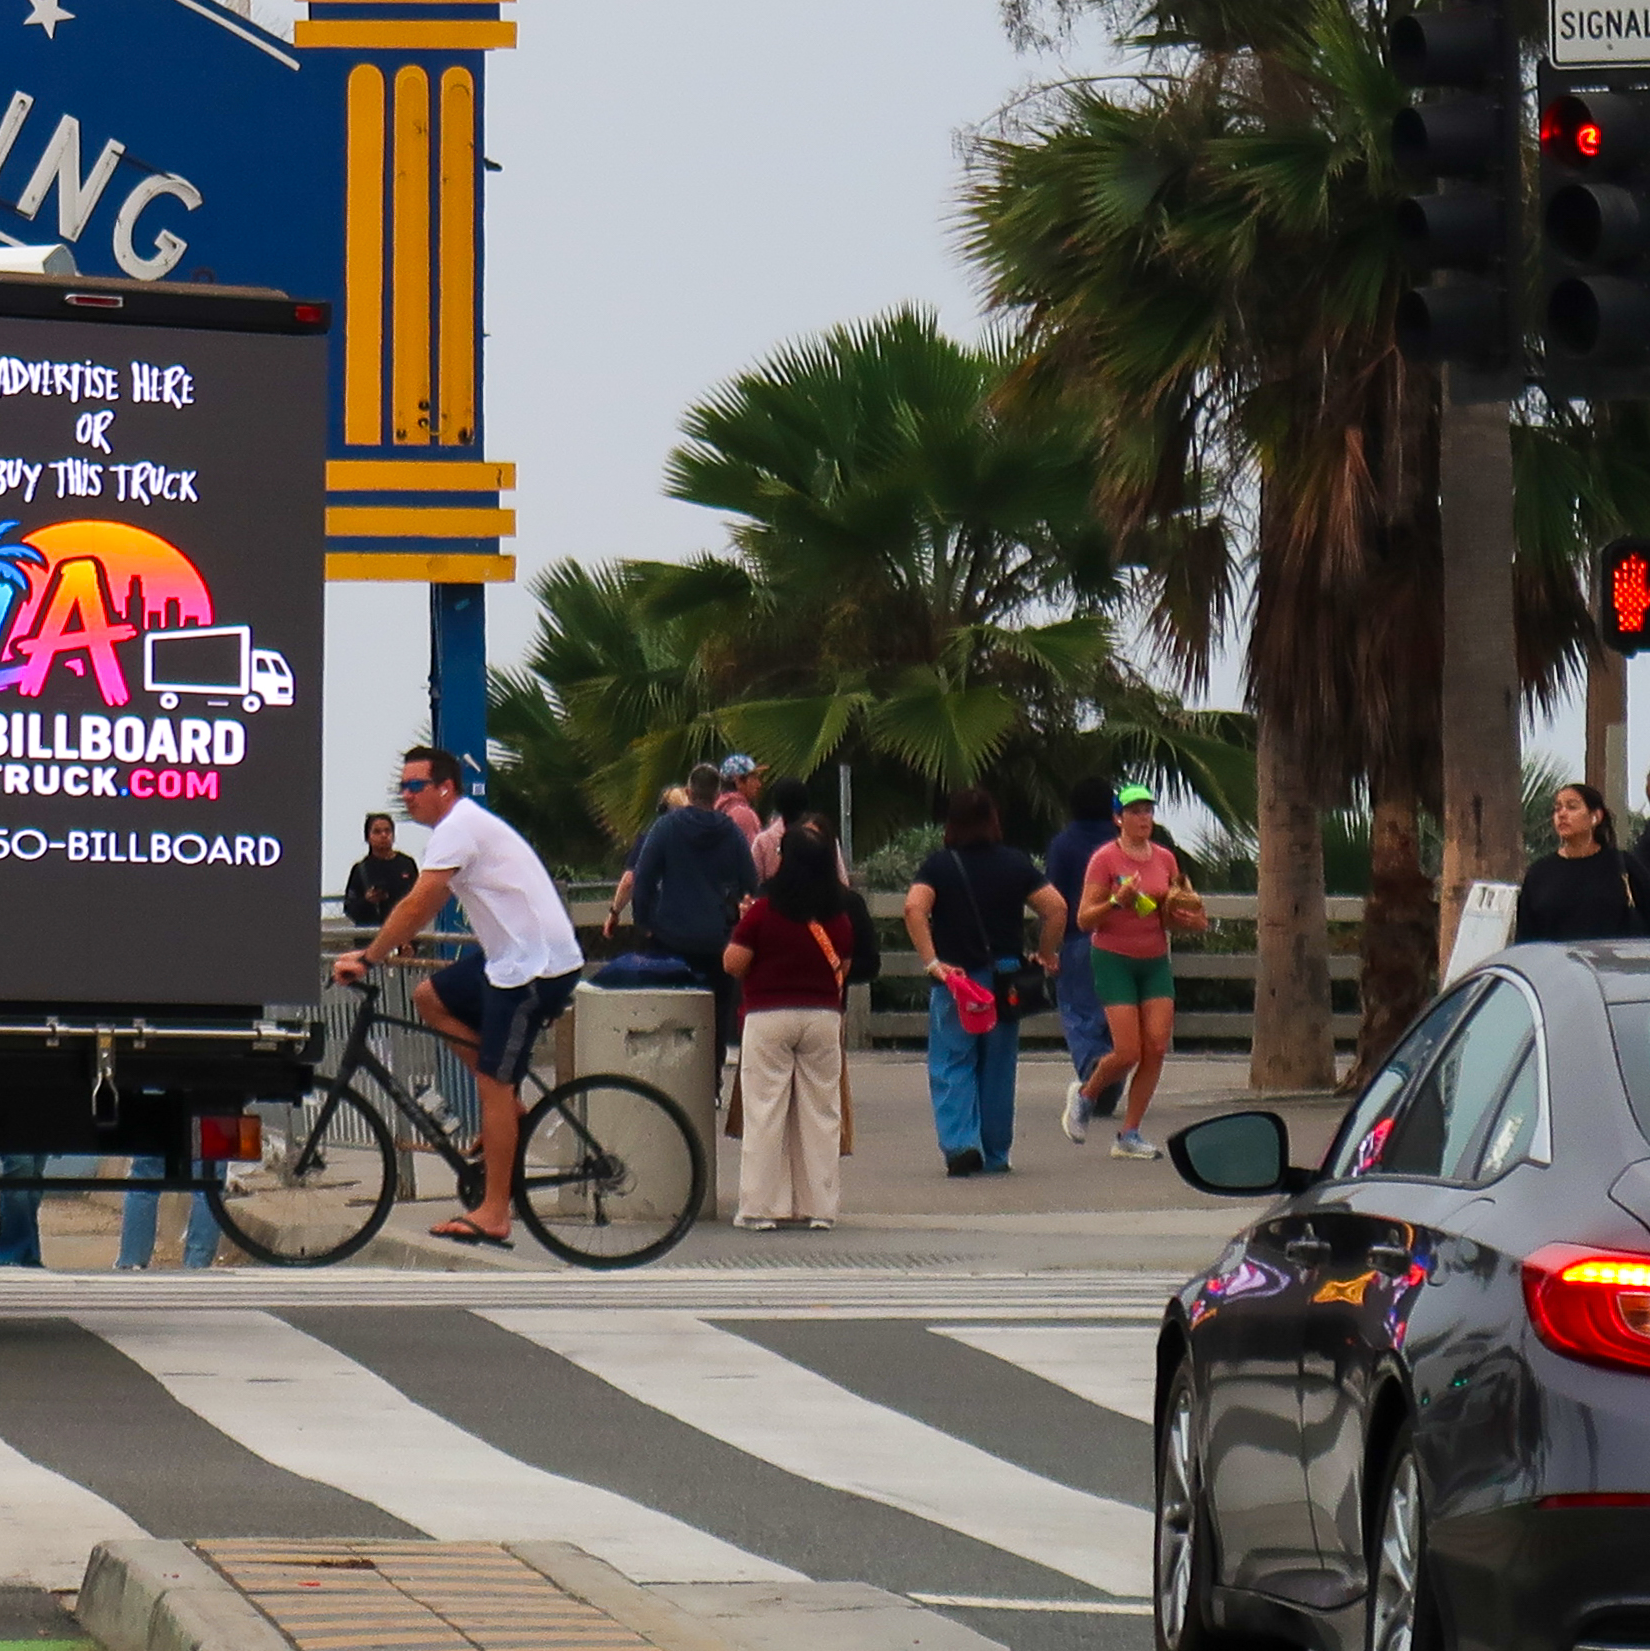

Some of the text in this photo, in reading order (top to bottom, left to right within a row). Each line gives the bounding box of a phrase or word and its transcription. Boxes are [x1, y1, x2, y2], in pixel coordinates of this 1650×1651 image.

[132, 360, 194, 409] HERE
[76, 410, 113, 454] OR
[49, 458, 101, 500] THIS
[110, 463, 197, 505] TRUCK
